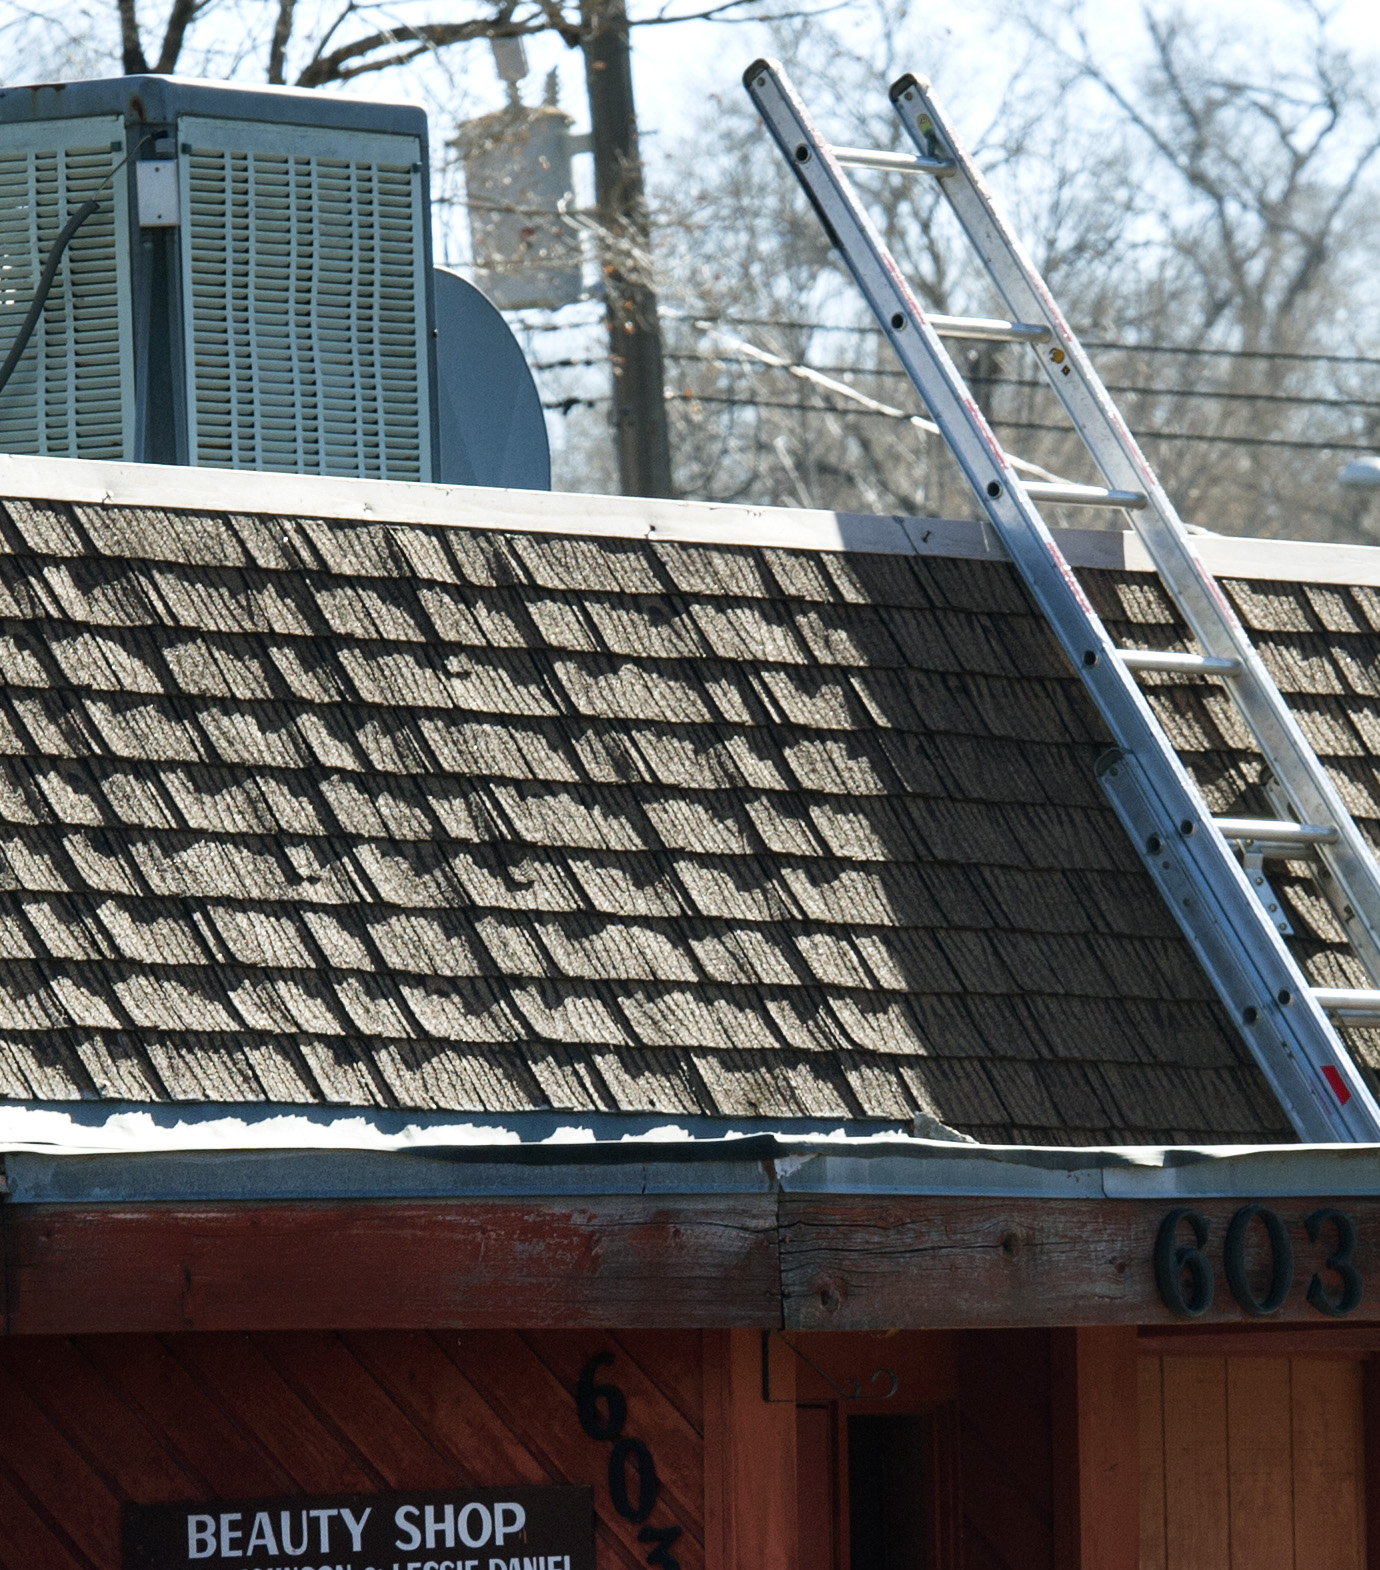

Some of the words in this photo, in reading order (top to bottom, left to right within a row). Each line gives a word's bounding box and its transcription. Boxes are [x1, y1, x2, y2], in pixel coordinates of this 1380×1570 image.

[1154, 1204, 1363, 1317] 603
[187, 1507, 372, 1559] BEAUTY
[394, 1502, 526, 1551] SHOP
